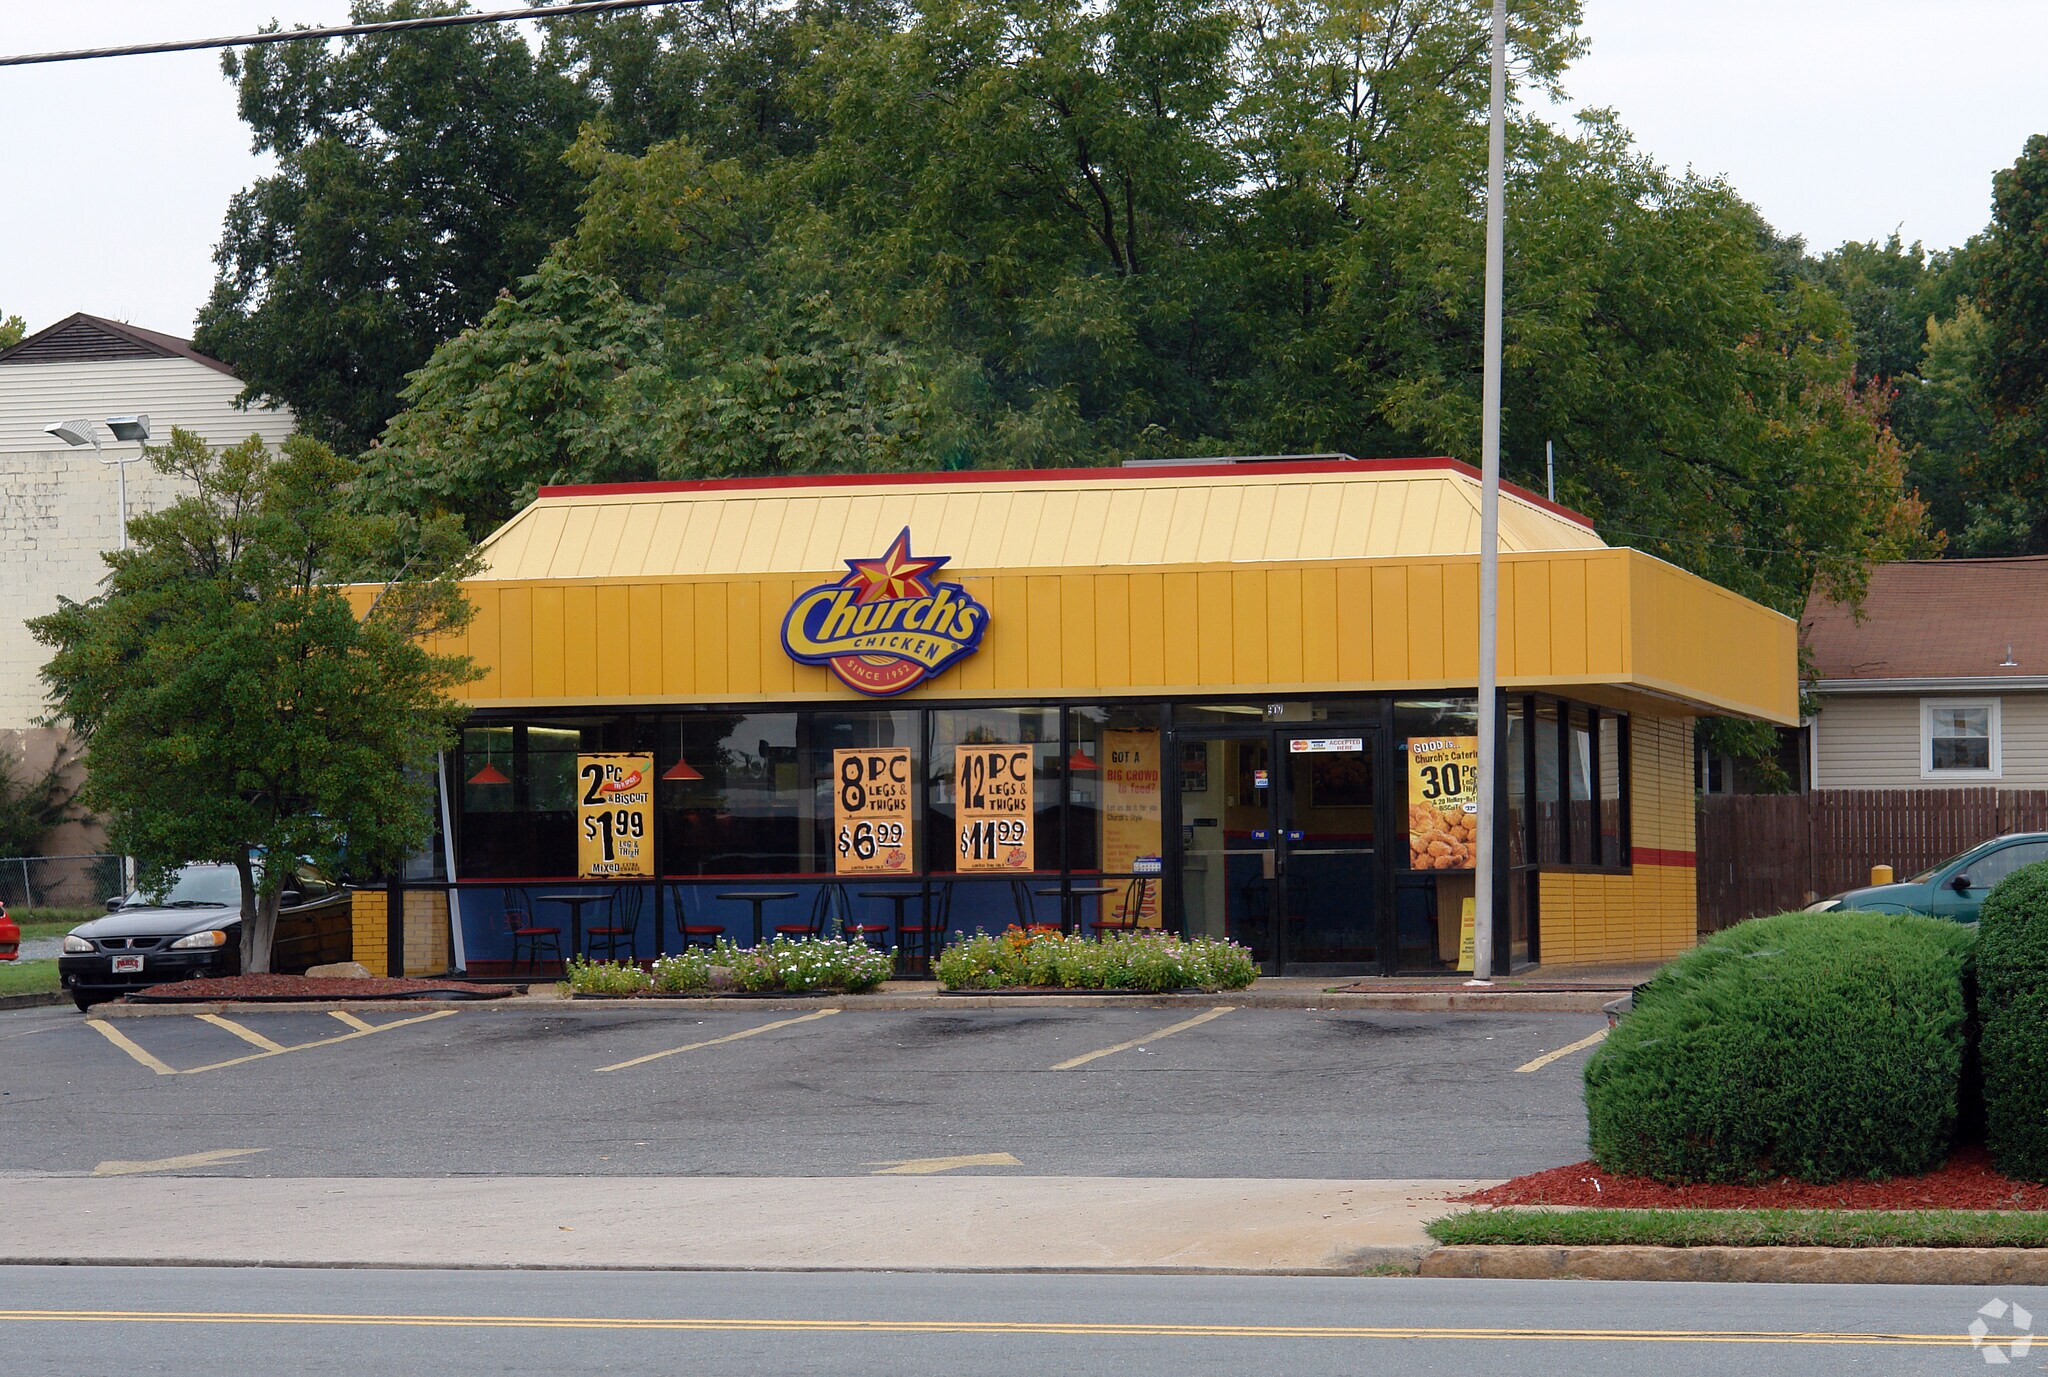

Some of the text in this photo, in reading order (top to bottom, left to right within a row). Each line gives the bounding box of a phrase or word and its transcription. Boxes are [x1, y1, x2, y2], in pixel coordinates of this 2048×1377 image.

[787, 589, 980, 656] Church's
[853, 635, 940, 661] CHICKEN
[846, 659, 911, 682] SINCE 1952
[1413, 741, 1444, 753] GOOD
[1112, 751, 1140, 763] GOT A
[1415, 752, 1449, 764] Church's
[961, 752, 1028, 810] 12 PC
[1107, 769, 1158, 782] BIG CROWD
[1420, 763, 1462, 799] 30
[581, 764, 623, 806] 2 PC
[842, 755, 907, 812] 8 PC
[868, 783, 907, 797] LEGS &
[989, 781, 1027, 796] LEGS &
[1118, 782, 1156, 794] to feed?
[869, 797, 907, 812] THIGHS
[989, 797, 1026, 812] THIGHS
[1107, 804, 1116, 812] Let
[1139, 804, 1147, 812] for
[1106, 814, 1143, 824] Church's Style
